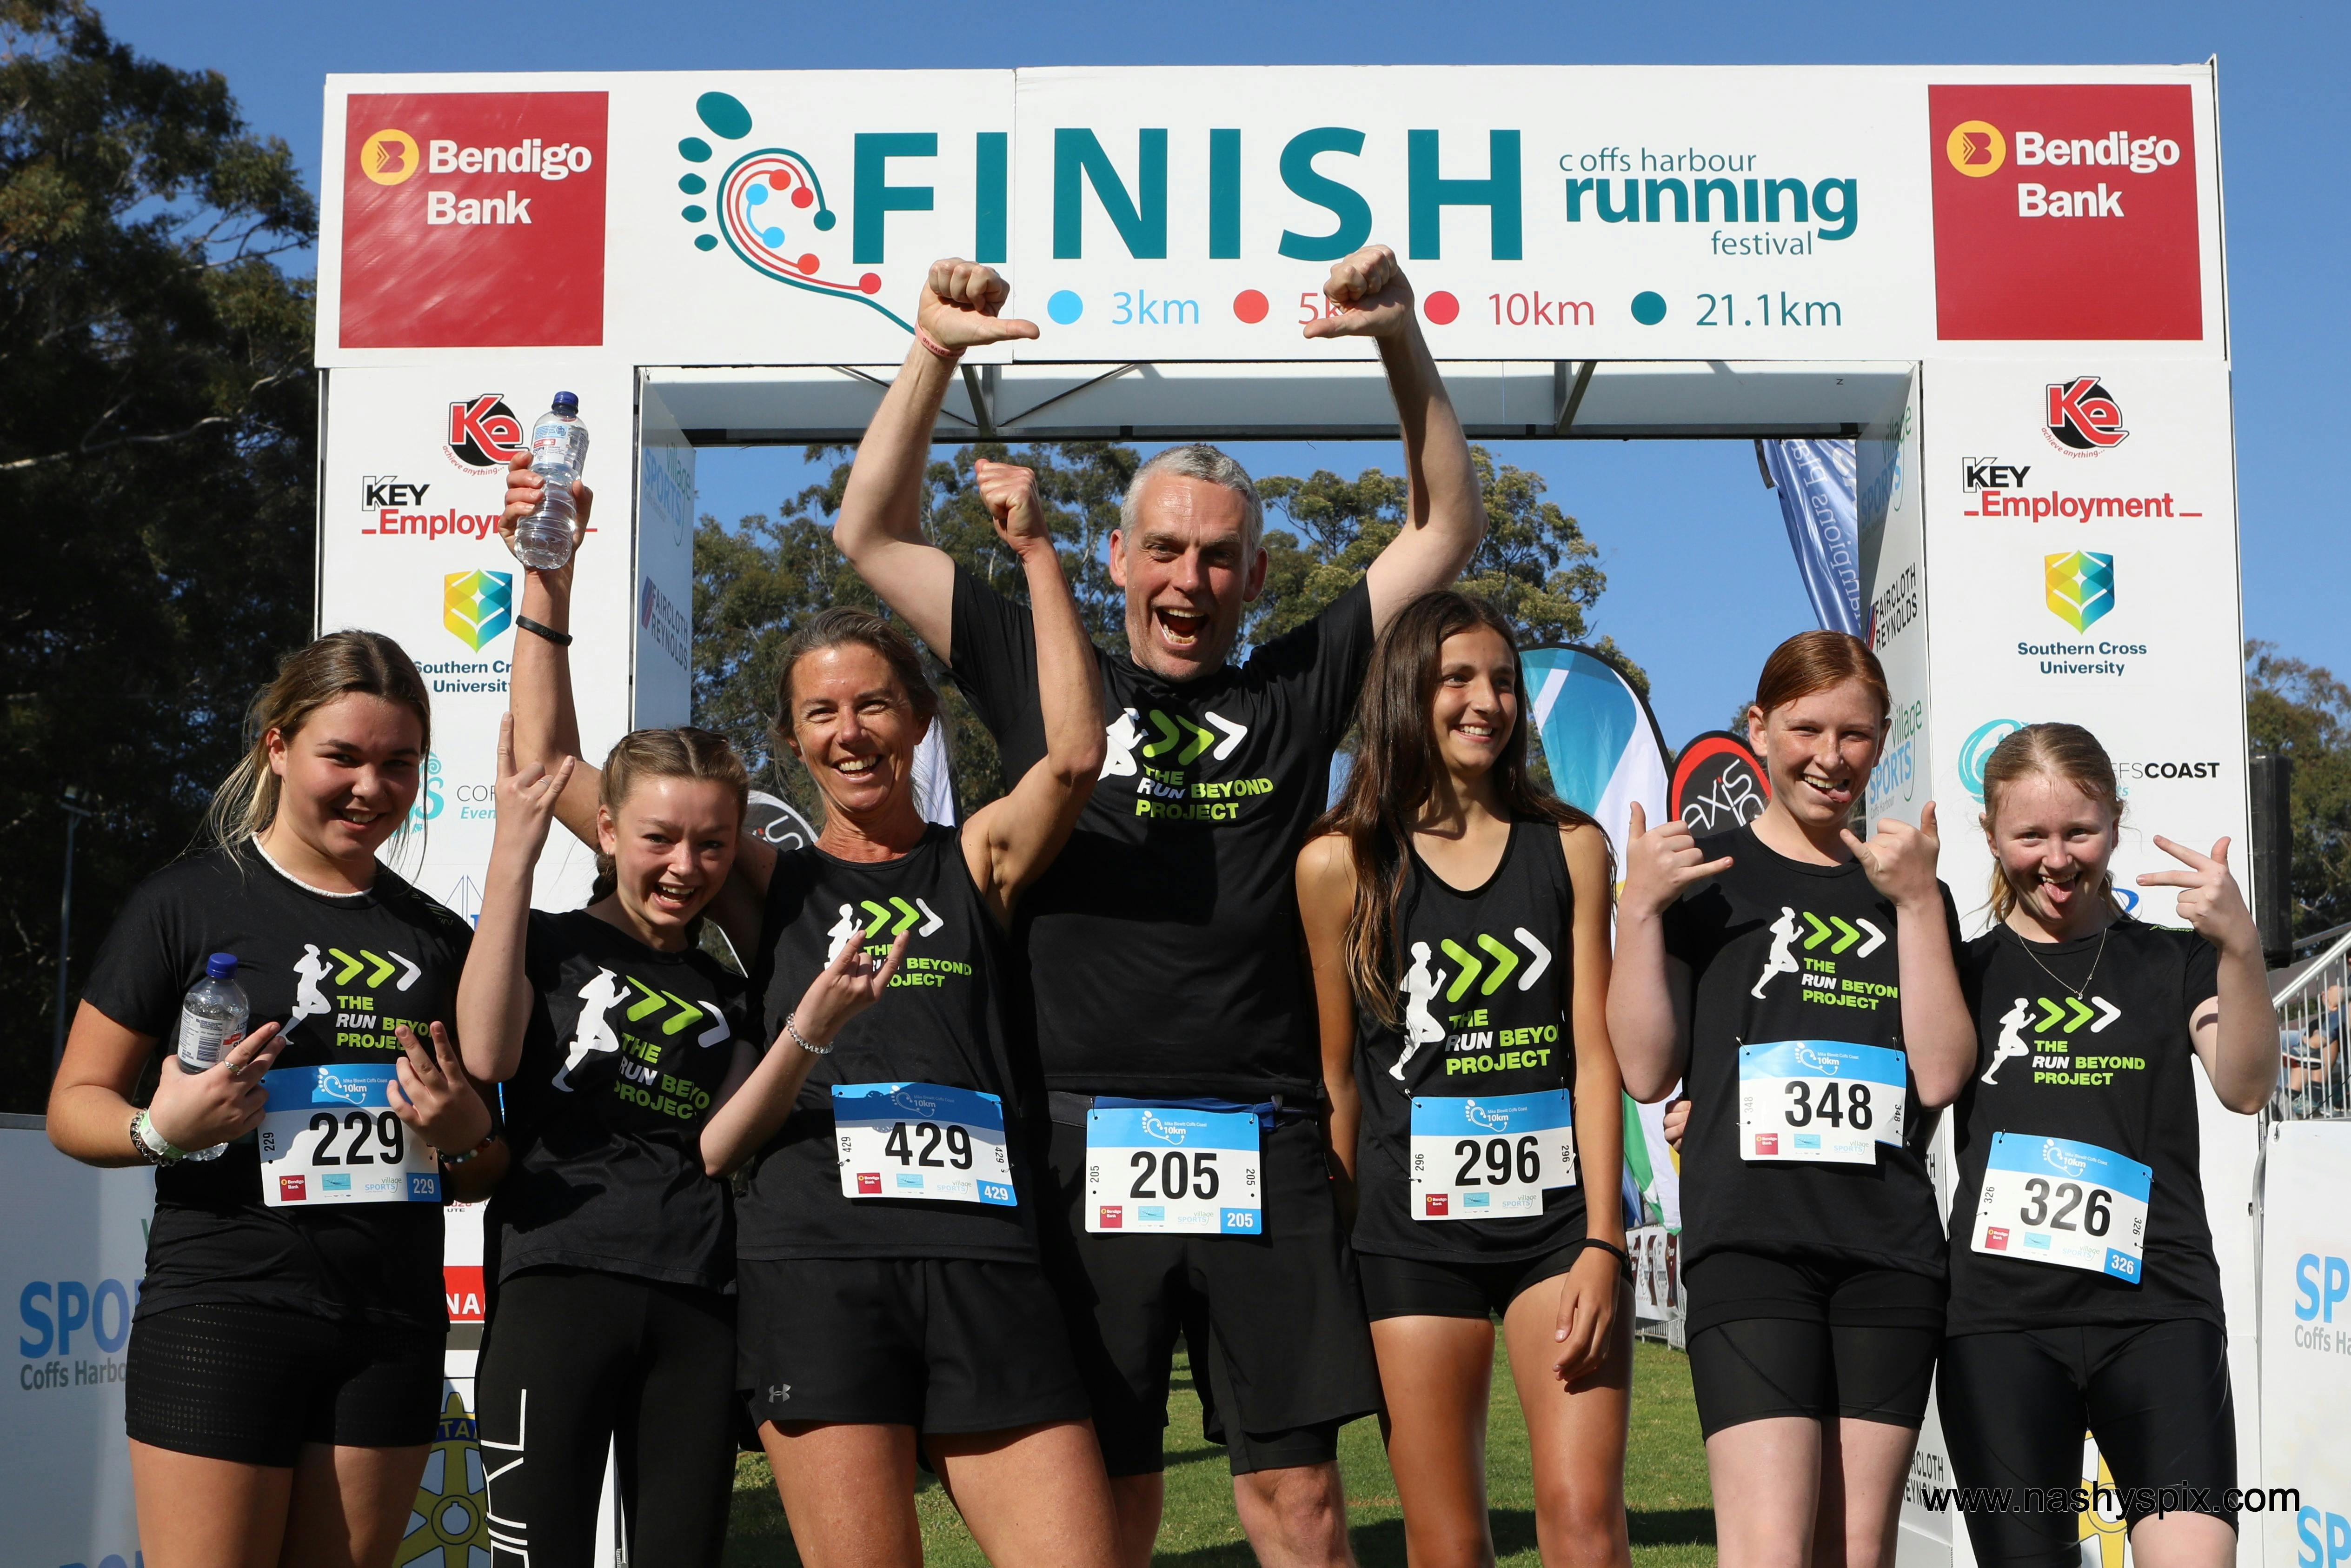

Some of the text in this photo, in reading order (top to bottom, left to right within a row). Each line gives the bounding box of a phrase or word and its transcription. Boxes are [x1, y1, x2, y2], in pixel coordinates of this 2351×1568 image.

[429, 139, 592, 180] Bendigo
[1641, 147, 1757, 172] harbour
[2015, 130, 2180, 173] Bendigo
[427, 190, 532, 224] Bank
[852, 127, 1522, 264] FINISH
[2018, 183, 2125, 217] Bank
[1565, 177, 1858, 241] running
[1711, 230, 1813, 255] festival
[1111, 290, 1199, 327] 3km
[1298, 290, 1344, 326] 5k
[1489, 291, 1594, 326] 10km
[1696, 291, 1841, 326] 21.1km
[2041, 428, 2063, 452] achieve
[443, 445, 463, 469] achieve
[644, 447, 681, 526] SPORTS
[1964, 460, 2031, 490] KEY
[364, 479, 430, 508] KEY
[1982, 491, 2174, 523] Employment
[379, 508, 501, 540] Employ
[1875, 562, 1916, 625] FAIRCLOTH
[652, 581, 688, 644] FAIRCLOTH
[1876, 593, 1918, 653] REYNOLDS
[651, 612, 687, 671] REYNOLDS
[2017, 642, 2147, 655] Southern Cross
[413, 661, 487, 674] Southern
[2040, 661, 2125, 676] University
[433, 679, 510, 692] Universit
[1891, 700, 1922, 756] village
[1143, 764, 1184, 785] THE
[1870, 741, 1912, 805] SPORTS
[1137, 777, 1274, 799] RUN BEYOND
[461, 807, 497, 819] Even
[1136, 799, 1239, 820] PROJECT
[907, 957, 972, 976] BEYOND
[1803, 957, 1835, 974] THE
[887, 973, 945, 987] OJECT
[1801, 974, 1898, 998] RUN BEYON
[336, 996, 373, 1010] THE
[1803, 989, 1879, 1010] PROJECT
[336, 1013, 377, 1029] RUN
[1449, 1009, 1488, 1030] THE
[622, 1031, 662, 1063] THE
[1445, 1024, 1559, 1051] RUN BEYO
[2034, 1040, 2068, 1052] THE
[1446, 1049, 1550, 1075] PROJECT
[1817, 1057, 1840, 1065] 10km
[2032, 1056, 2145, 1070] RUN BEYOND
[343, 1084, 367, 1092] 10km
[2034, 1072, 2113, 1085] PROJECT
[662, 1074, 710, 1109] BEYO
[1744, 1096, 1753, 1113] 348
[1785, 1081, 1873, 1130] 348
[263, 1132, 275, 1151] 229
[310, 1111, 404, 1166] 229
[841, 1136, 851, 1153] 429
[885, 1122, 972, 1170] 429
[995, 1147, 1004, 1163] 429
[1415, 1154, 1424, 1171] 296
[1454, 1136, 1540, 1186] 296
[1561, 1145, 1570, 1163] 296
[2064, 1157, 2086, 1168] 10km
[413, 1178, 434, 1194] 229
[1090, 1166, 1099, 1183] 205
[1130, 1151, 1219, 1200] 205
[1246, 1169, 1255, 1185] 205
[984, 1185, 1009, 1201] 429
[1984, 1186, 1995, 1203] 326
[2020, 1177, 2112, 1237] 326
[1227, 1213, 1253, 1228] 205
[2132, 1217, 2142, 1236] 326
[2063, 1248, 2092, 1258] SPORTS
[2079, 1245, 2100, 1255] village
[2111, 1255, 2134, 1274] 326
[20, 1279, 142, 1358] SPO
[2295, 1324, 2331, 1352] Coffs
[20, 1357, 126, 1390] Coffs Harbo
